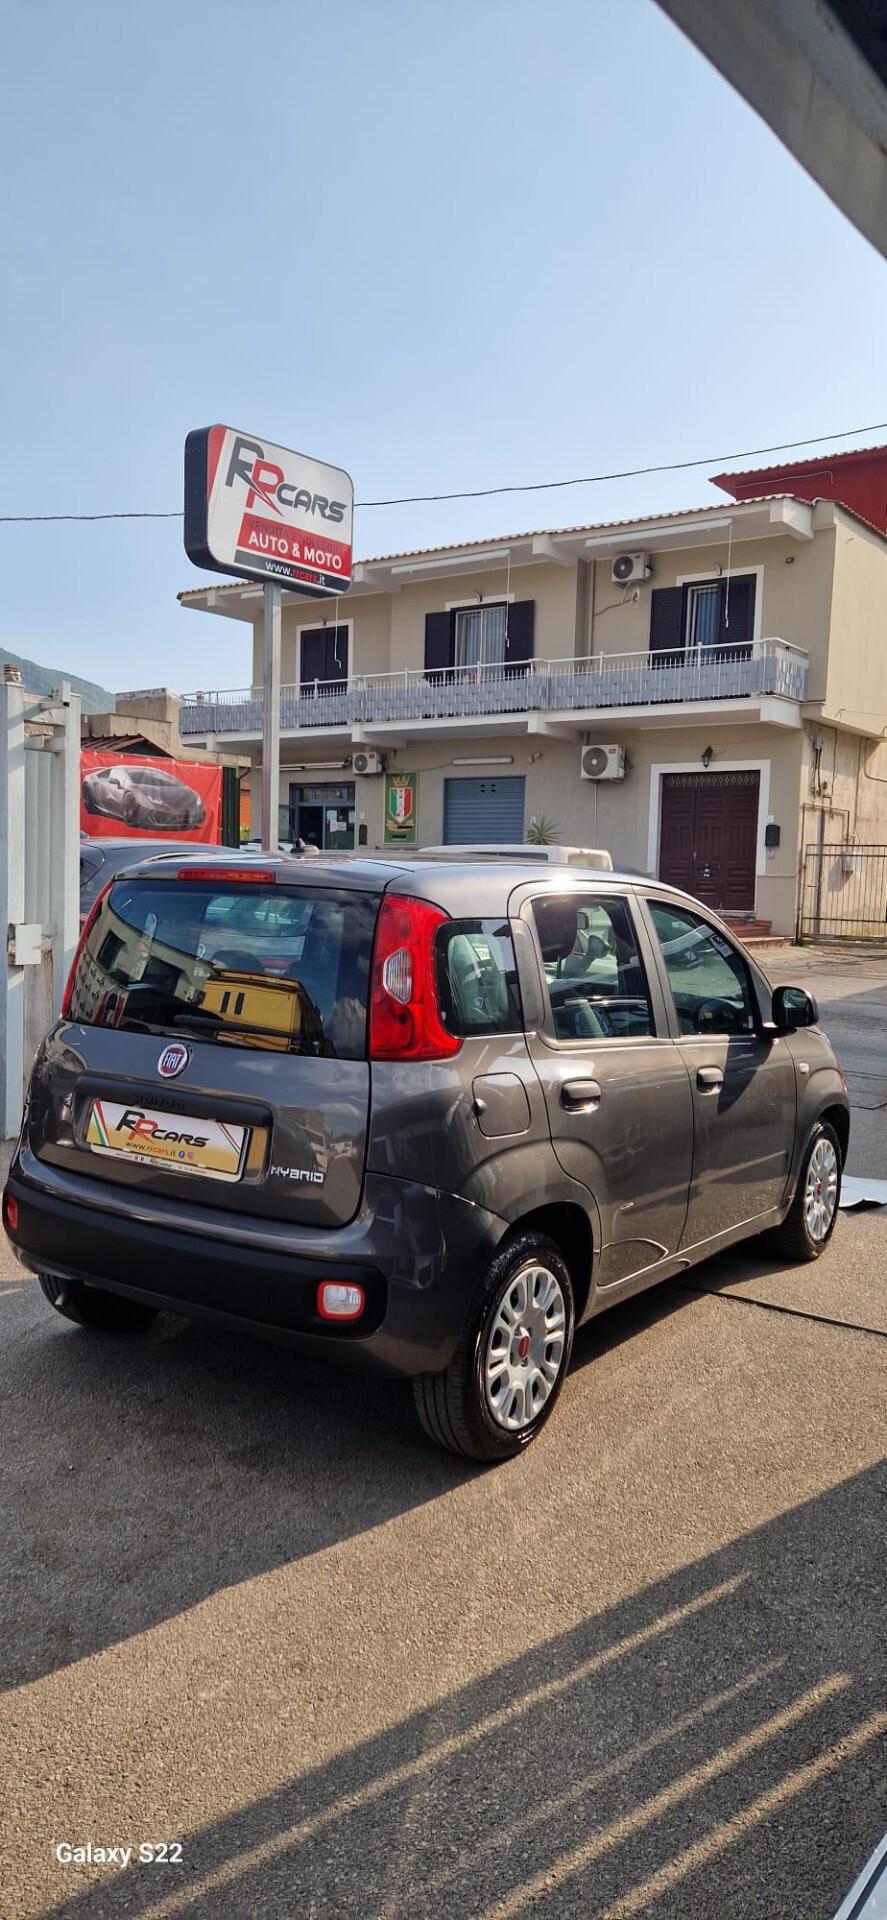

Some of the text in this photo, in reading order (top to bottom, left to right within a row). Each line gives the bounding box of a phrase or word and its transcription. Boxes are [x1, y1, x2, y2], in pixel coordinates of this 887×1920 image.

[248, 531, 342, 570] AUTO & MOTO
[265, 561, 326, 585] www.rrcars.it
[163, 1052, 183, 1070] FIAT
[125, 1140, 176, 1157] www.rrcars.it
[270, 1165, 325, 1184] HYBRID
